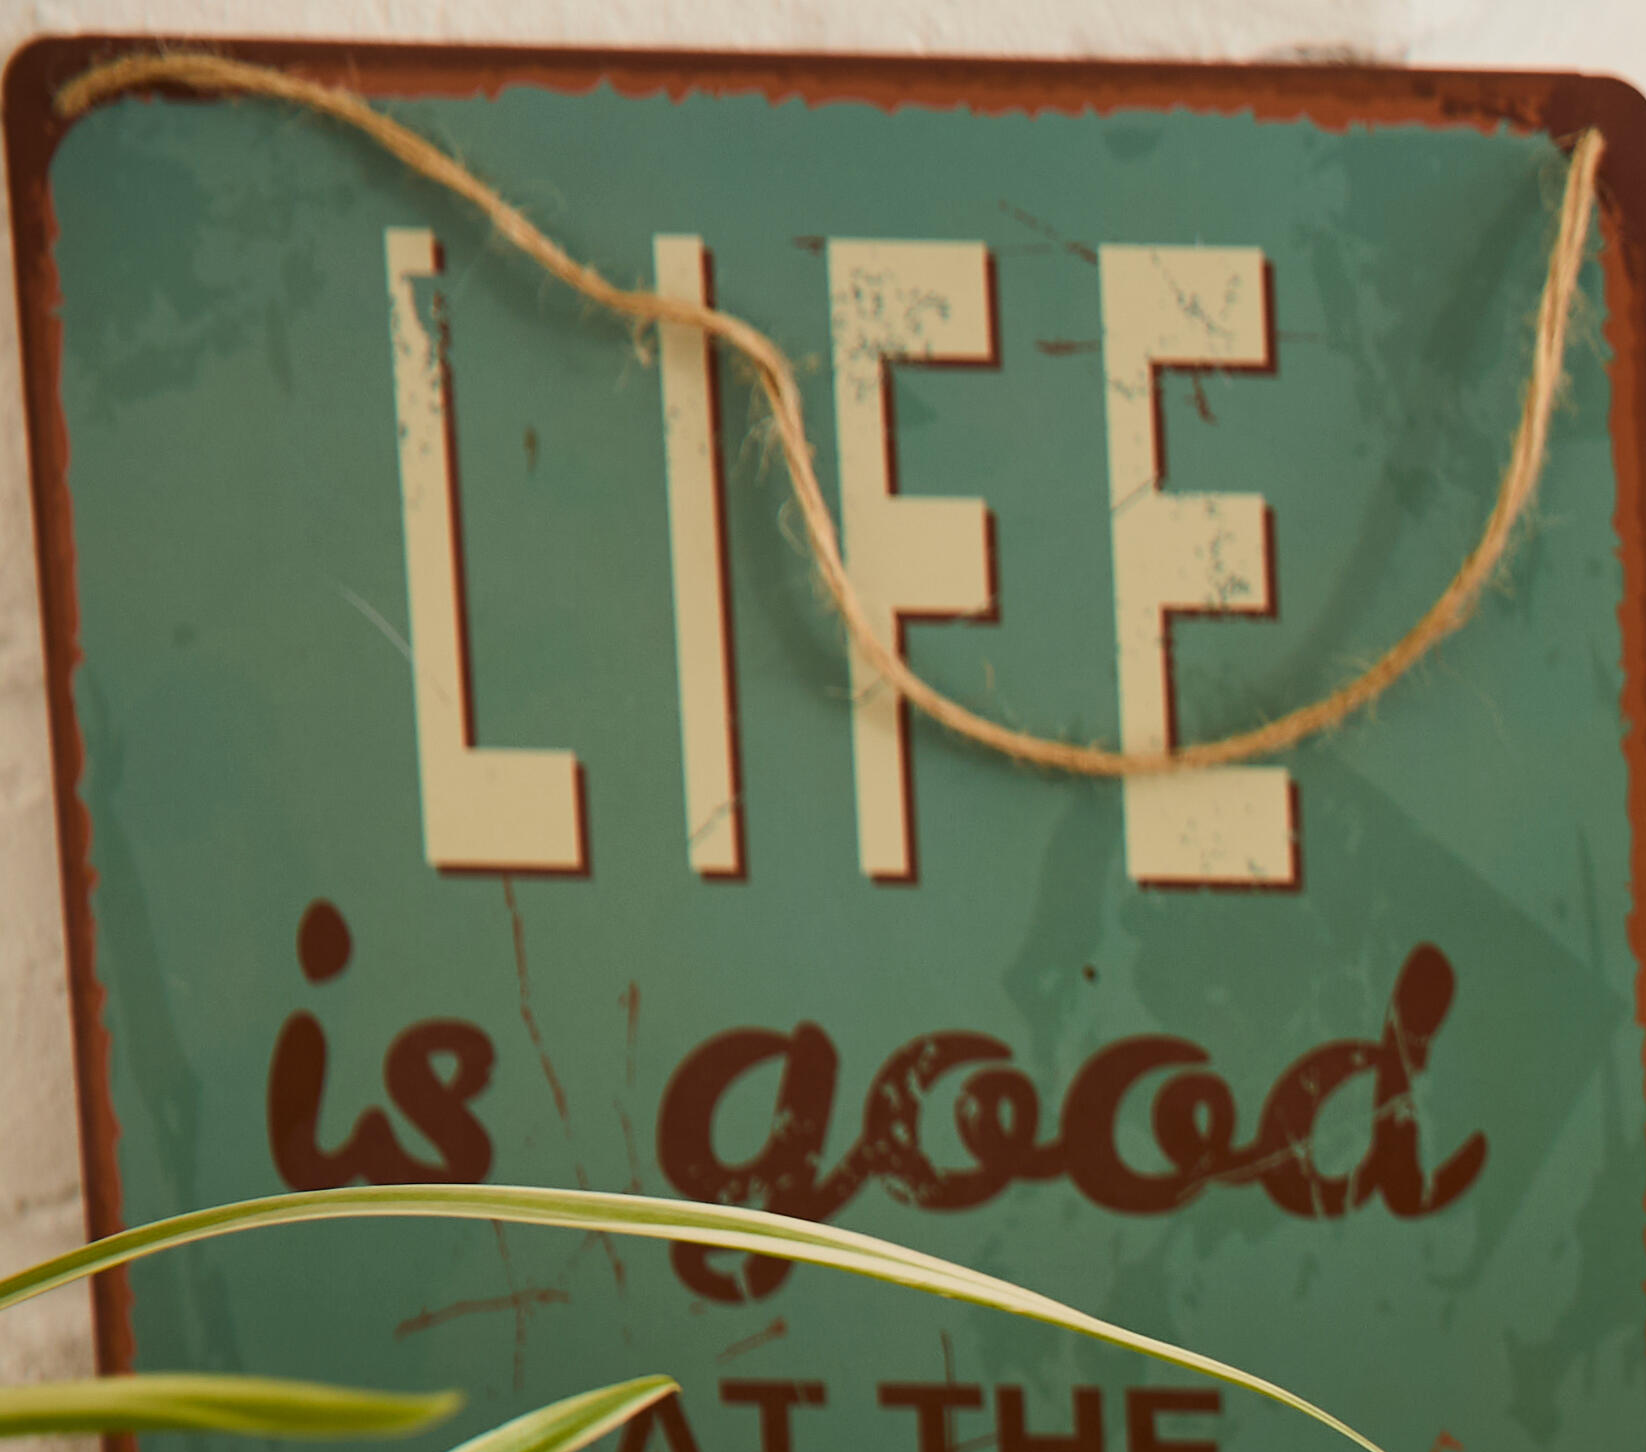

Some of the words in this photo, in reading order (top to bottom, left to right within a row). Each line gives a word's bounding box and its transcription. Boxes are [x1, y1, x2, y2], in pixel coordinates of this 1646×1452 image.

[385, 228, 1302, 888] LIFE
[267, 897, 496, 1193] is
[657, 942, 1488, 1304] good
